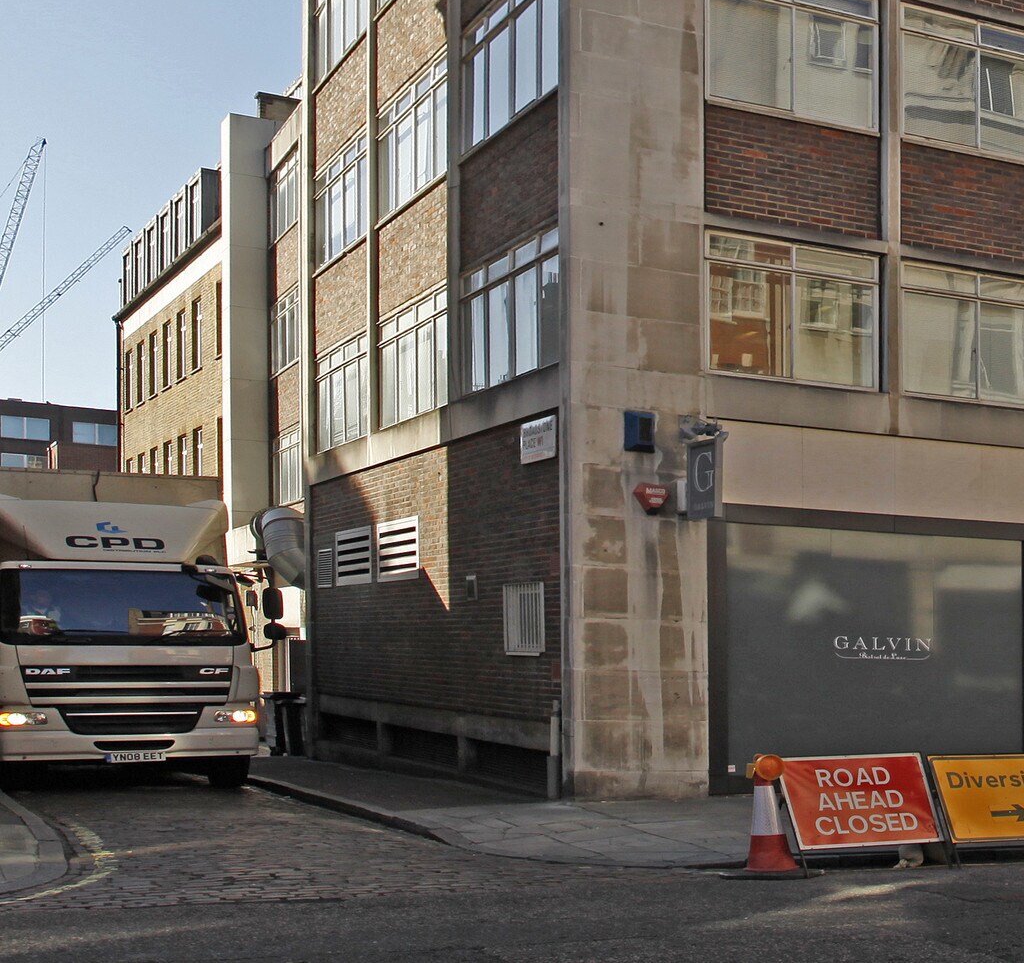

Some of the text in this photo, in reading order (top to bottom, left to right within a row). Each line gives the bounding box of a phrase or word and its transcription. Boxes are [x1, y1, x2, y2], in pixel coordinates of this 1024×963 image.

[693, 451, 715, 492] G
[65, 535, 165, 550] CPD
[833, 635, 931, 652] GALVIN
[199, 667, 229, 675] CF
[112, 752, 164, 761] YN08 EET
[814, 766, 891, 788] ROAD
[818, 789, 904, 812] AHEAD
[815, 812, 918, 836] CLOSED
